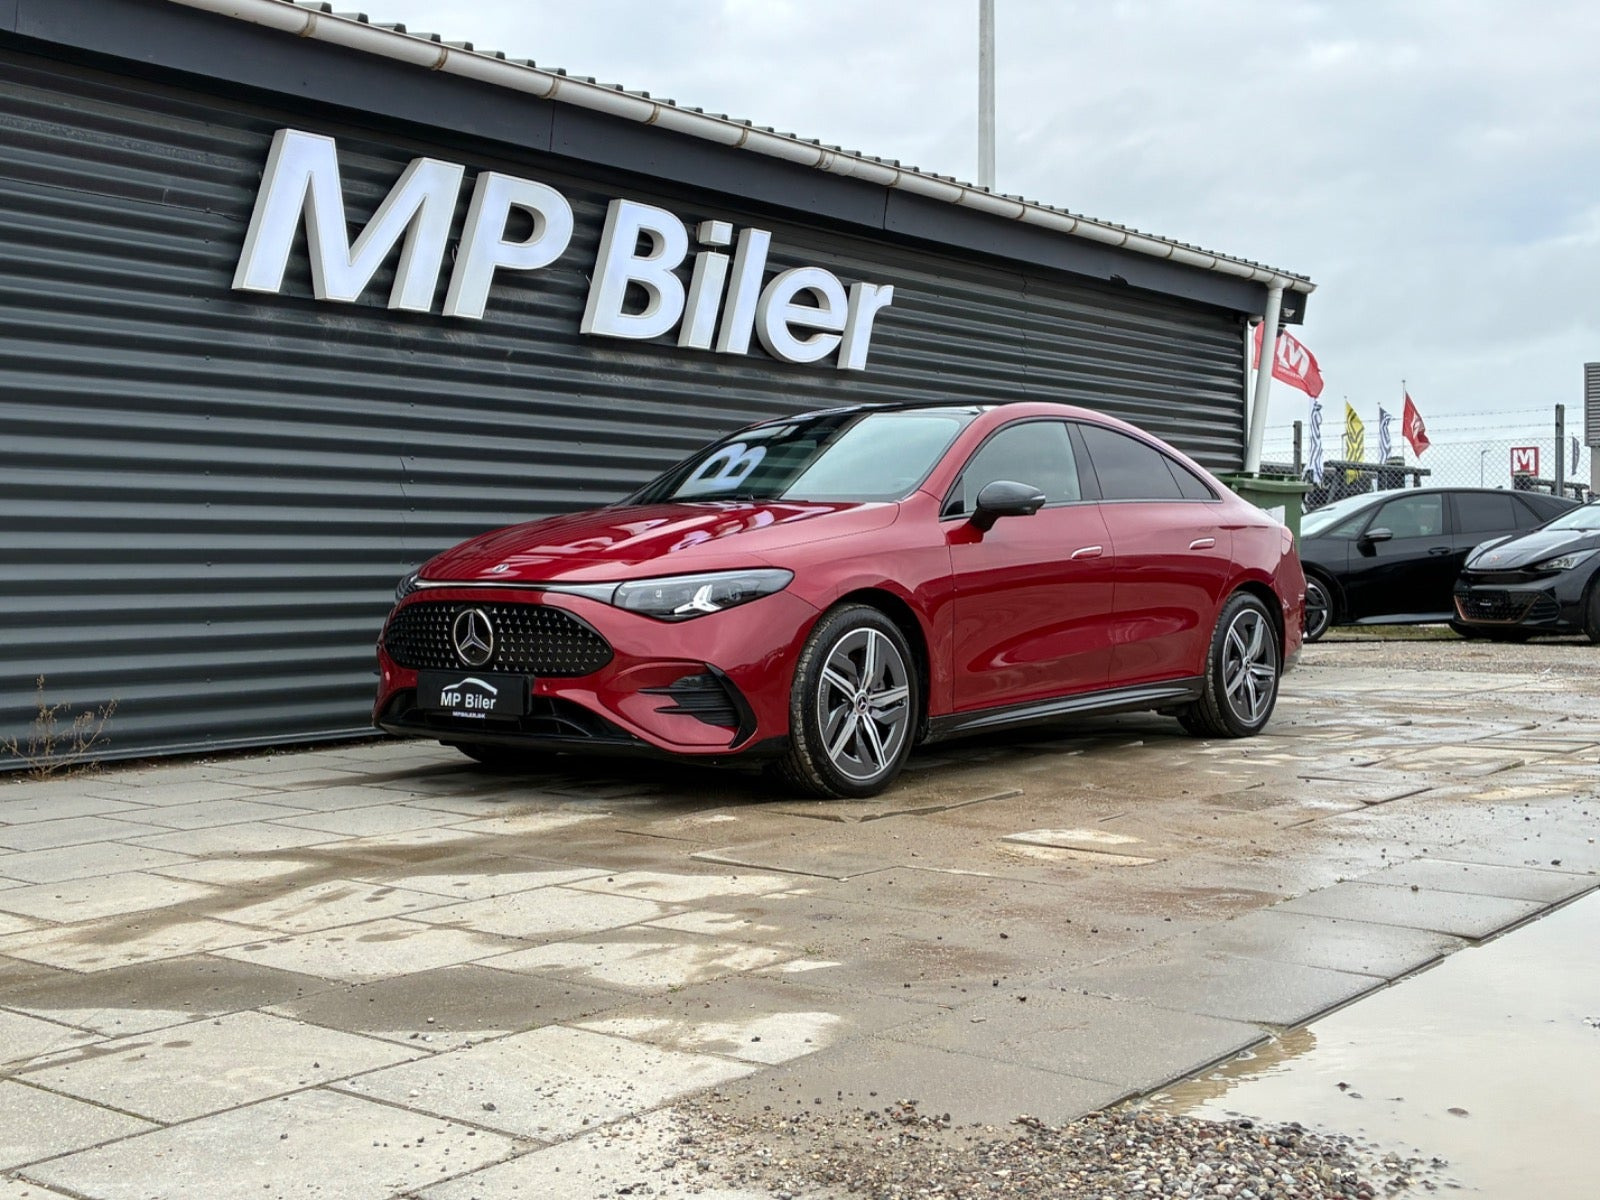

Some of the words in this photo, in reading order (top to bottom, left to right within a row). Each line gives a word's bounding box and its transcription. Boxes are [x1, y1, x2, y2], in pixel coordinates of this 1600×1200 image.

[232, 128, 574, 320] MP
[580, 198, 894, 370] Biler
[440, 692, 461, 706] MP
[465, 693, 496, 709] Biler
